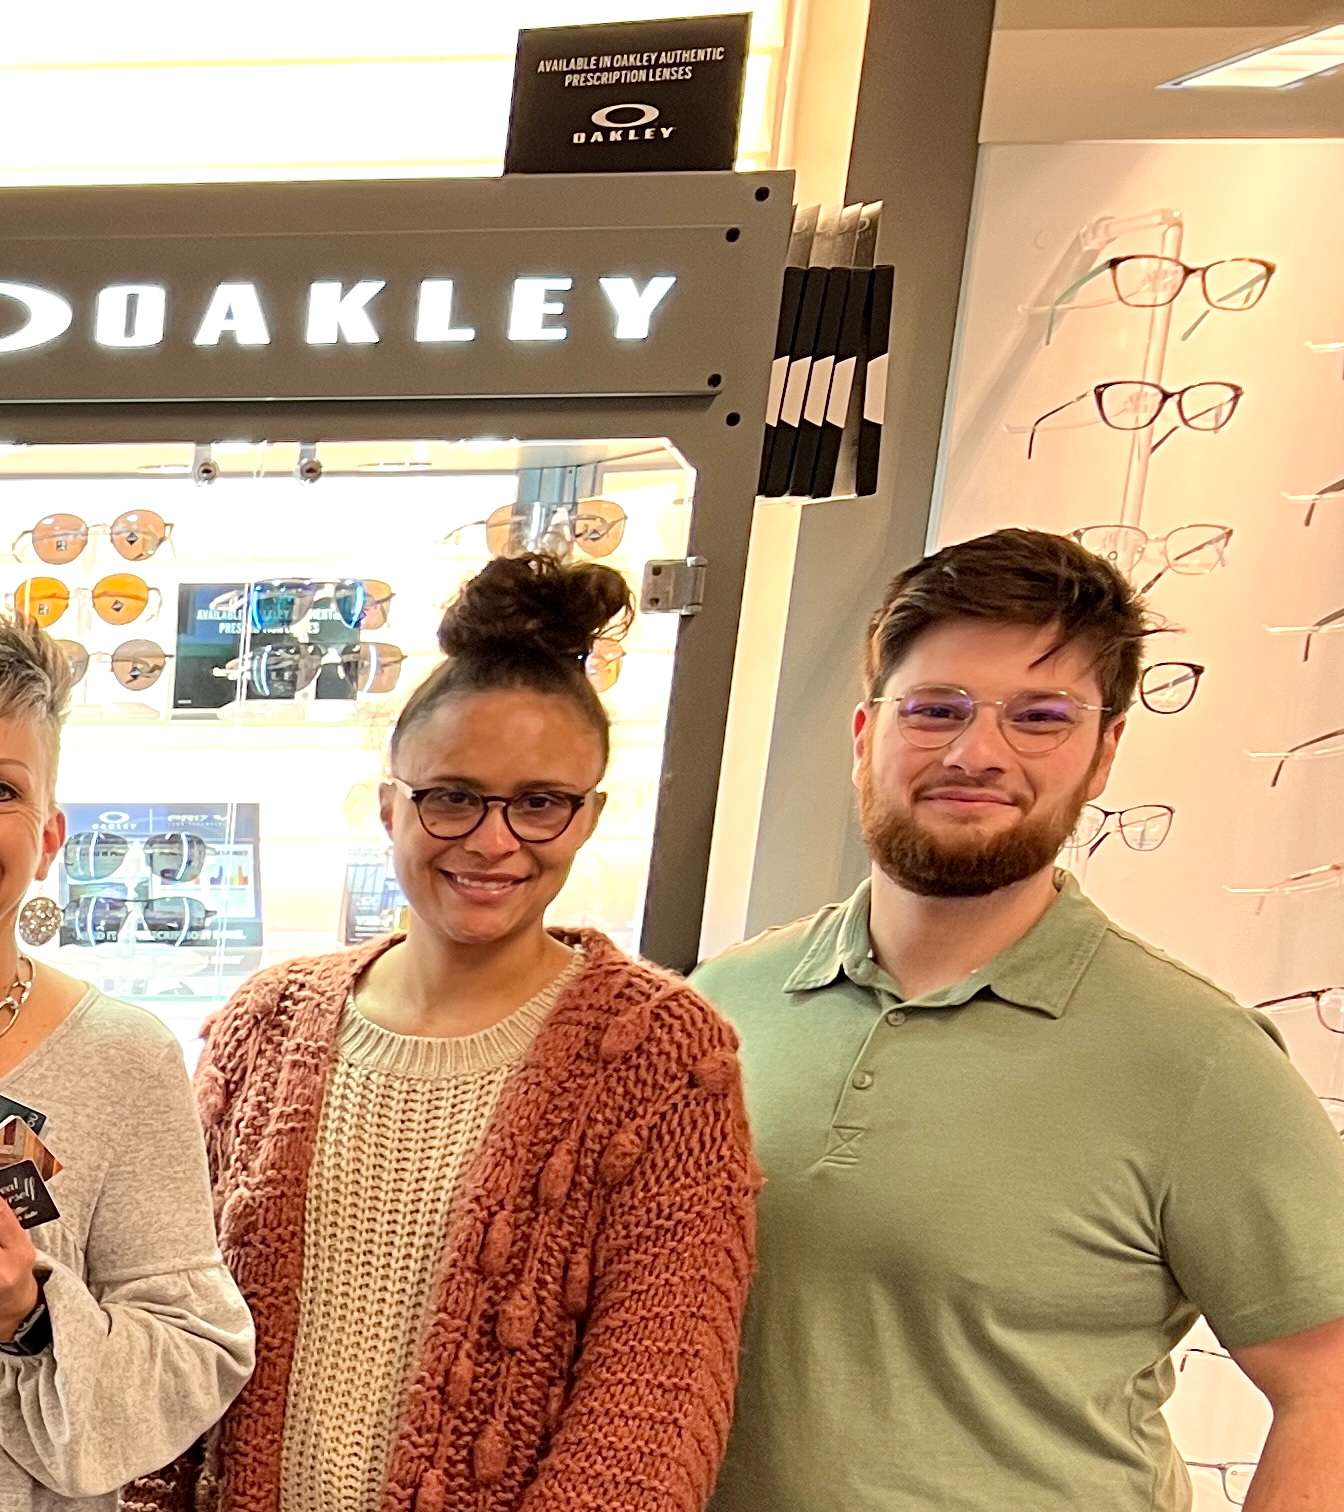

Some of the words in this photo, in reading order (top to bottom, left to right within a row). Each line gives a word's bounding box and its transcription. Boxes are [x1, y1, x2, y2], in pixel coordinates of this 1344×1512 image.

[537, 55, 597, 73] AVAILABLE
[598, 54, 612, 69] IN
[613, 51, 659, 67] OAKLEY
[658, 46, 726, 65] AUTHENTIC
[564, 68, 647, 87] PRESCRIPTION
[648, 66, 693, 82] LENSES
[572, 127, 675, 144] OAKLEY
[94, 274, 678, 348] OAKLEY
